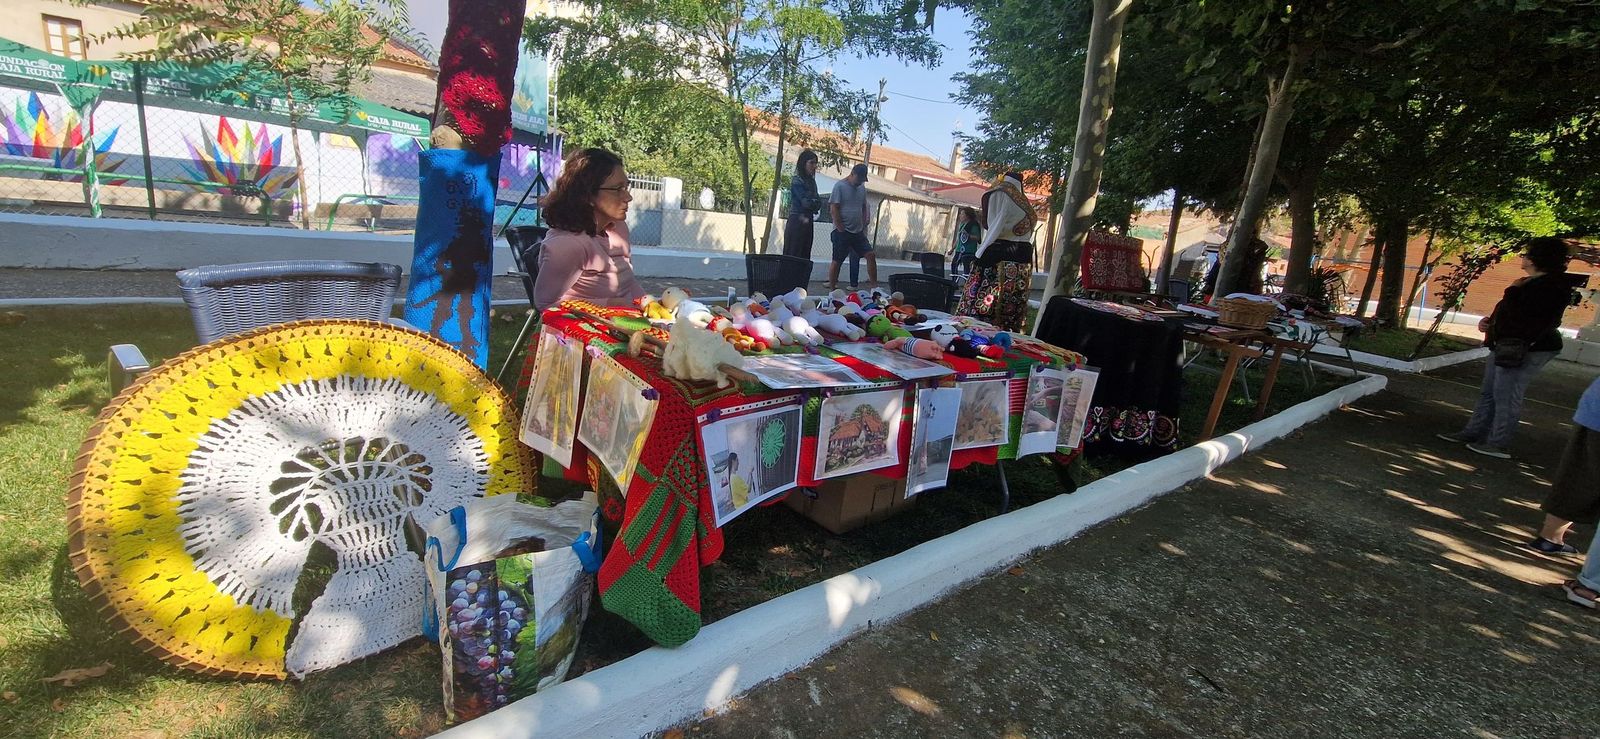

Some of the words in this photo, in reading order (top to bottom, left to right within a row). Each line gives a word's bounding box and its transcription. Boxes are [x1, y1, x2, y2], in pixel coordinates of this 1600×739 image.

[0, 63, 23, 74] AJA
[24, 66, 67, 80] RURAL
[367, 115, 390, 127] CAJA
[391, 119, 422, 132] RURAL
